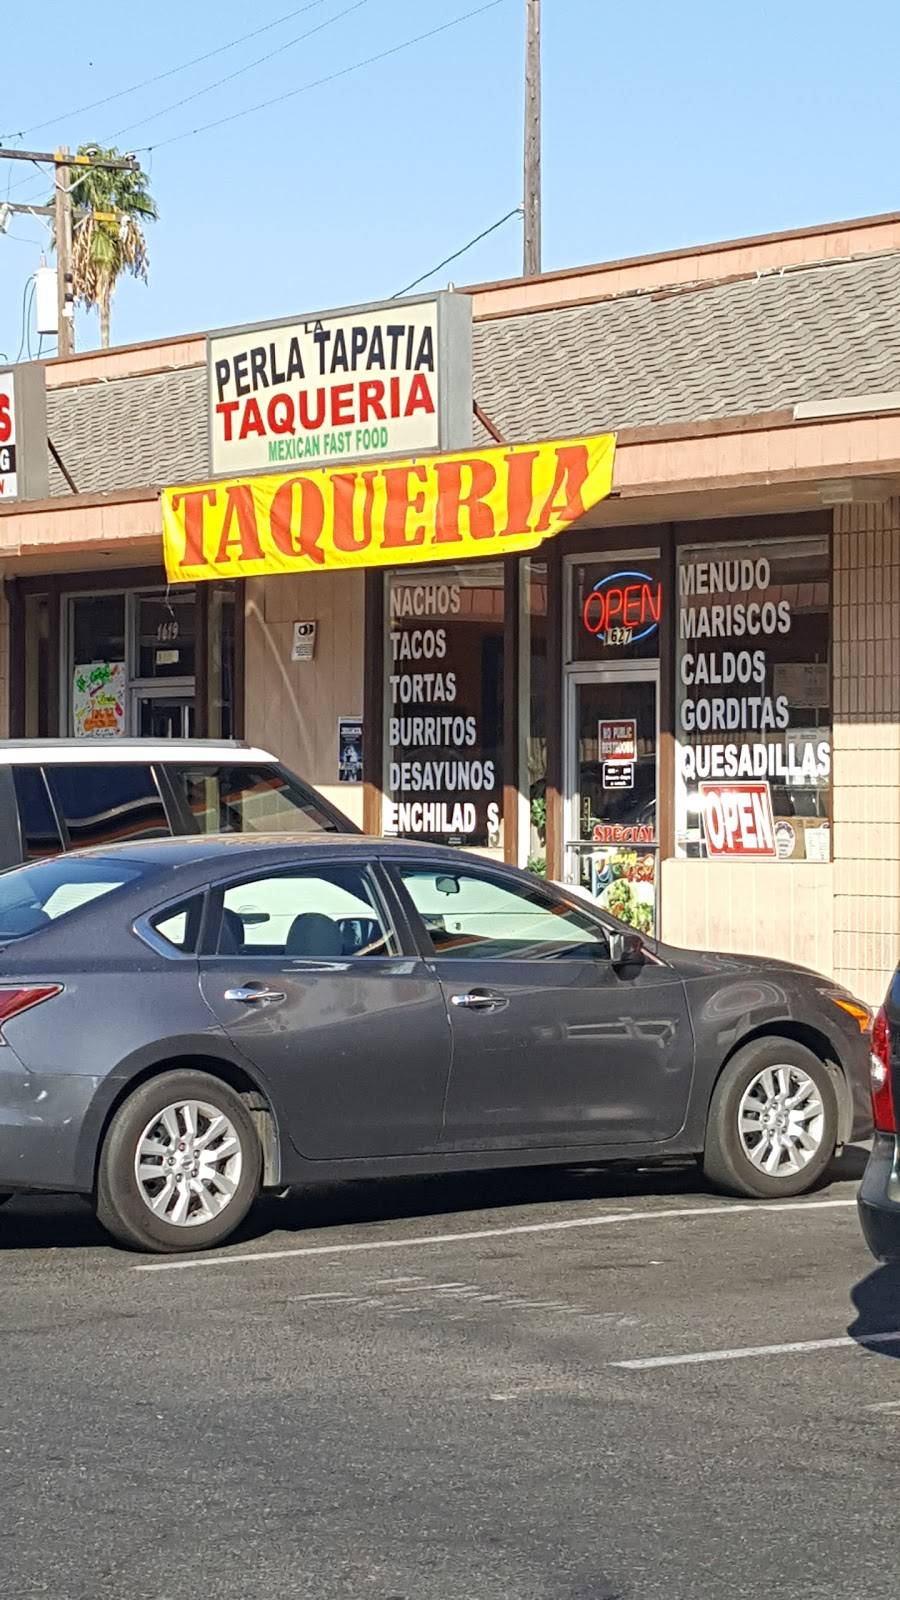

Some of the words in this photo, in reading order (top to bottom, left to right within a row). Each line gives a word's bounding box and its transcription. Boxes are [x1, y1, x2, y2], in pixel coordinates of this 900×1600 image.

[304, 320, 324, 334] LA
[215, 337, 305, 402] PERLA
[314, 325, 434, 375] TAPATIA
[216, 373, 435, 441] TAQUERIA
[268, 433, 320, 462] MEXICAN
[323, 431, 352, 455] FAST
[355, 426, 388, 451] FOOD
[172, 445, 589, 566] TAQUERIA
[679, 557, 770, 596] MENUDO
[389, 584, 461, 617] NACHOS
[584, 581, 662, 632] OPEN
[679, 601, 791, 640] MARISCOS
[389, 629, 446, 661] TACOS
[680, 650, 766, 686] CALDOS
[389, 672, 456, 703] TORTAS
[389, 716, 476, 746] BURRITOS
[680, 695, 790, 732] GORDITAS
[389, 760, 495, 791] DESAYUNOS
[680, 742, 830, 780] QUESADILLAS
[704, 790, 774, 849] OPEN
